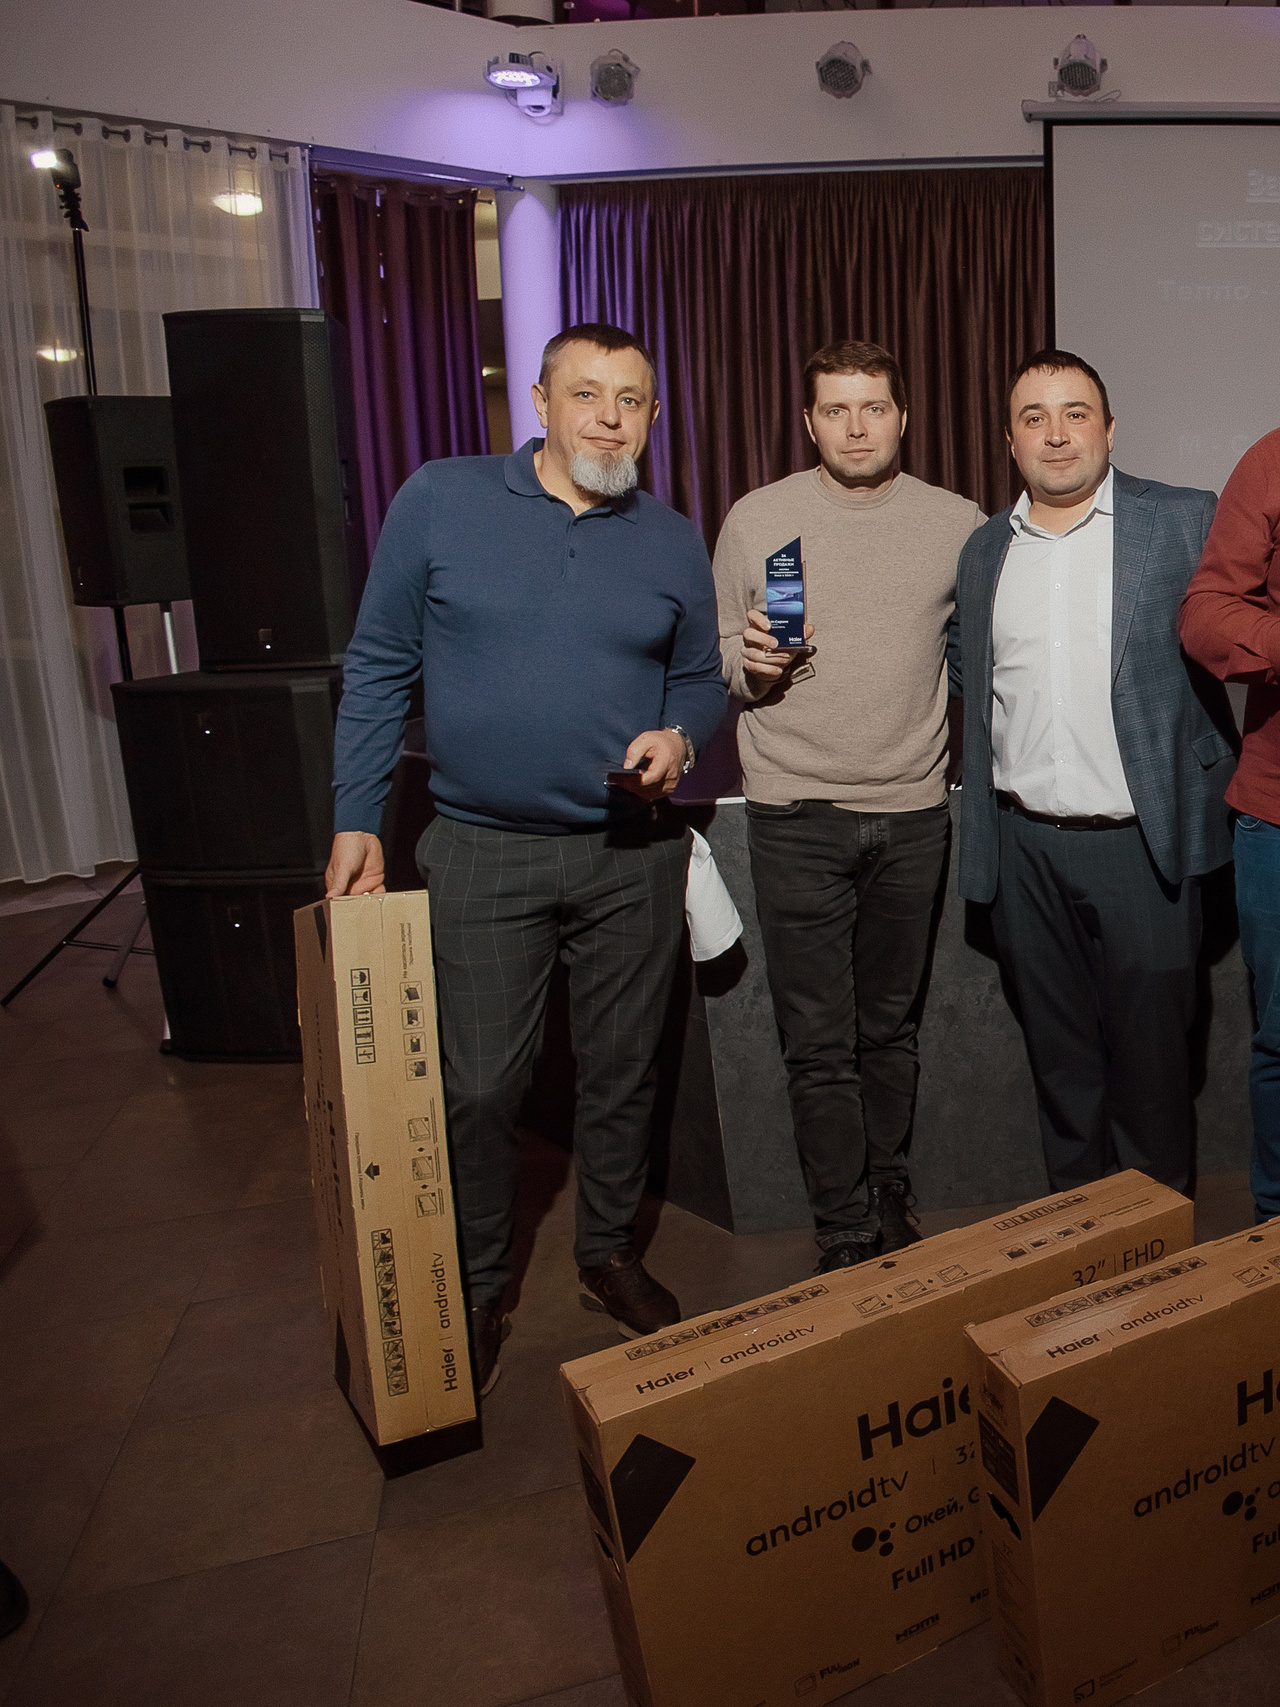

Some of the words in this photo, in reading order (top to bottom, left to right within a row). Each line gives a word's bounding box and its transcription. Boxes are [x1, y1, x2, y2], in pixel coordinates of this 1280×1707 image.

[1122, 1238, 1165, 1271] FHD
[430, 1252, 451, 1329] androidtv
[635, 1365, 696, 1395] Haier
[719, 1324, 816, 1364] androidtv
[1045, 1332, 1100, 1360] Haier
[1120, 1293, 1205, 1332] androidtv
[440, 1348, 458, 1392] Haier
[856, 1376, 972, 1462] Hai
[1133, 1436, 1276, 1519] androidtv
[745, 1470, 909, 1558] androidtv
[891, 1554, 935, 1591] Full
[938, 1535, 977, 1569] HD
